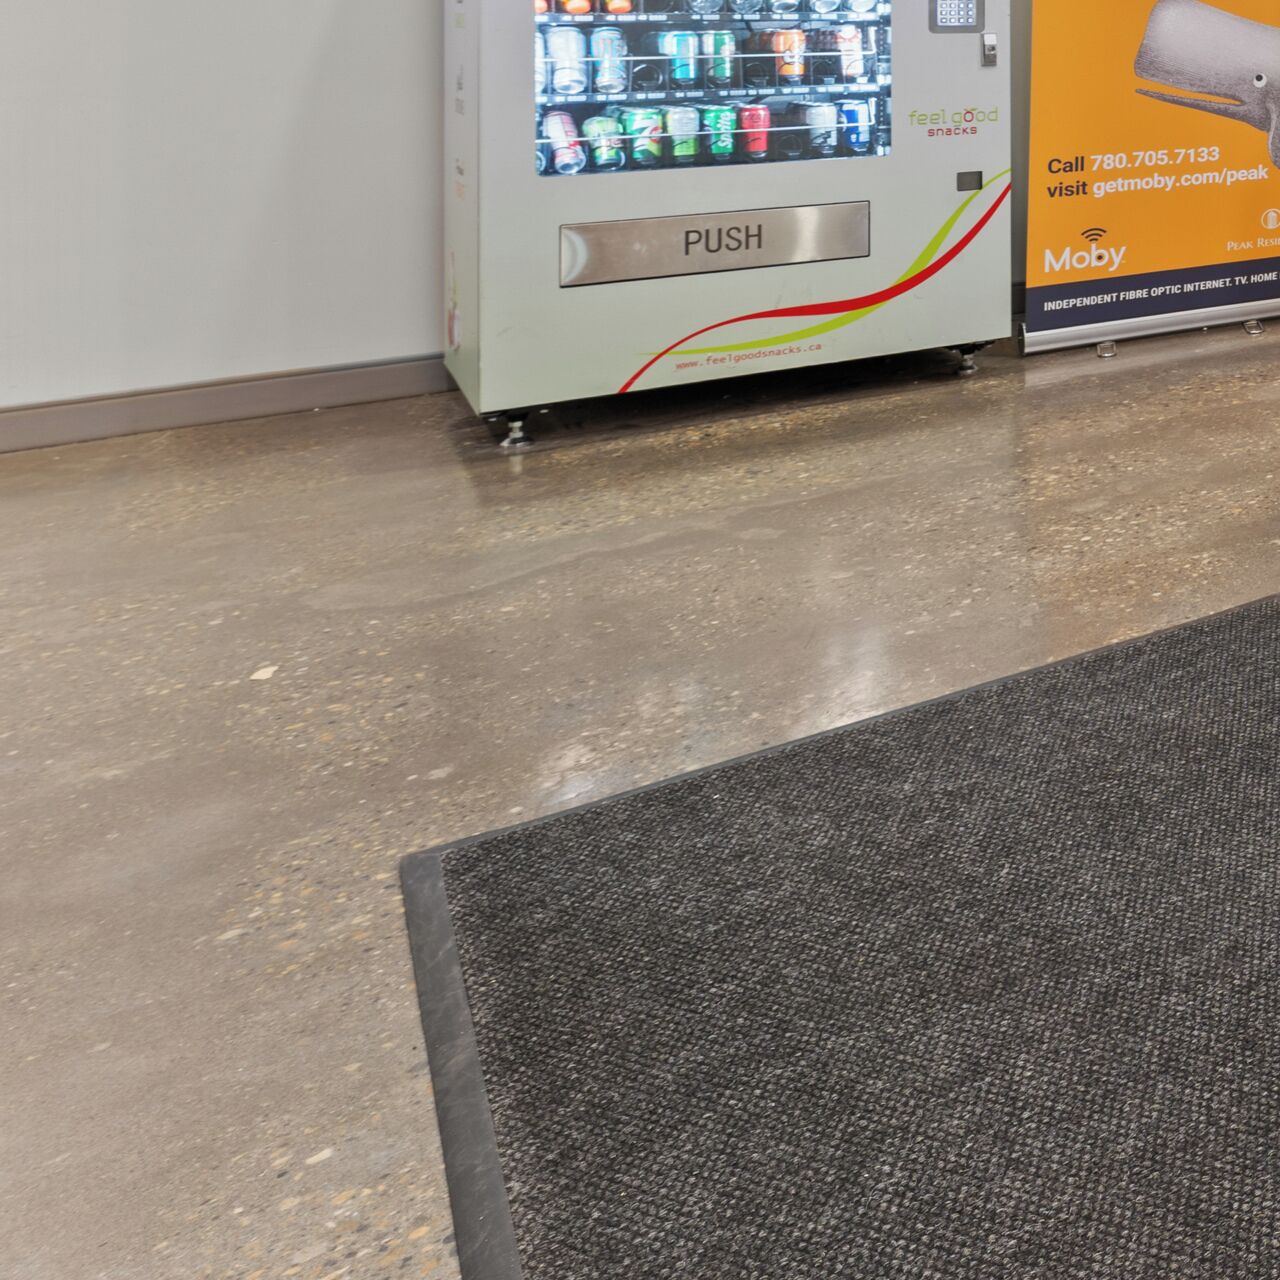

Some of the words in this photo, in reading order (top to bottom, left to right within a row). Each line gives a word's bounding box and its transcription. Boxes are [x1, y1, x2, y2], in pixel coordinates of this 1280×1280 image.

[908, 109, 947, 126] feel
[951, 106, 999, 127] good
[927, 126, 978, 137] snacks
[1047, 156, 1085, 175] Call
[1090, 146, 1221, 172] 780.705.7133
[1047, 181, 1088, 198] visit
[1093, 164, 1269, 199] getmoby.com/peak
[683, 224, 763, 256] PUSH
[1044, 242, 1127, 274] Moby
[1043, 292, 1118, 312] INDEPENDENT
[1119, 288, 1149, 301] FIBRE
[1150, 284, 1182, 297] OPTIC
[1183, 277, 1233, 293] INTERNET.
[1250, 271, 1278, 284] HOME
[674, 343, 823, 371] www.feelgoodsnacks.ca
